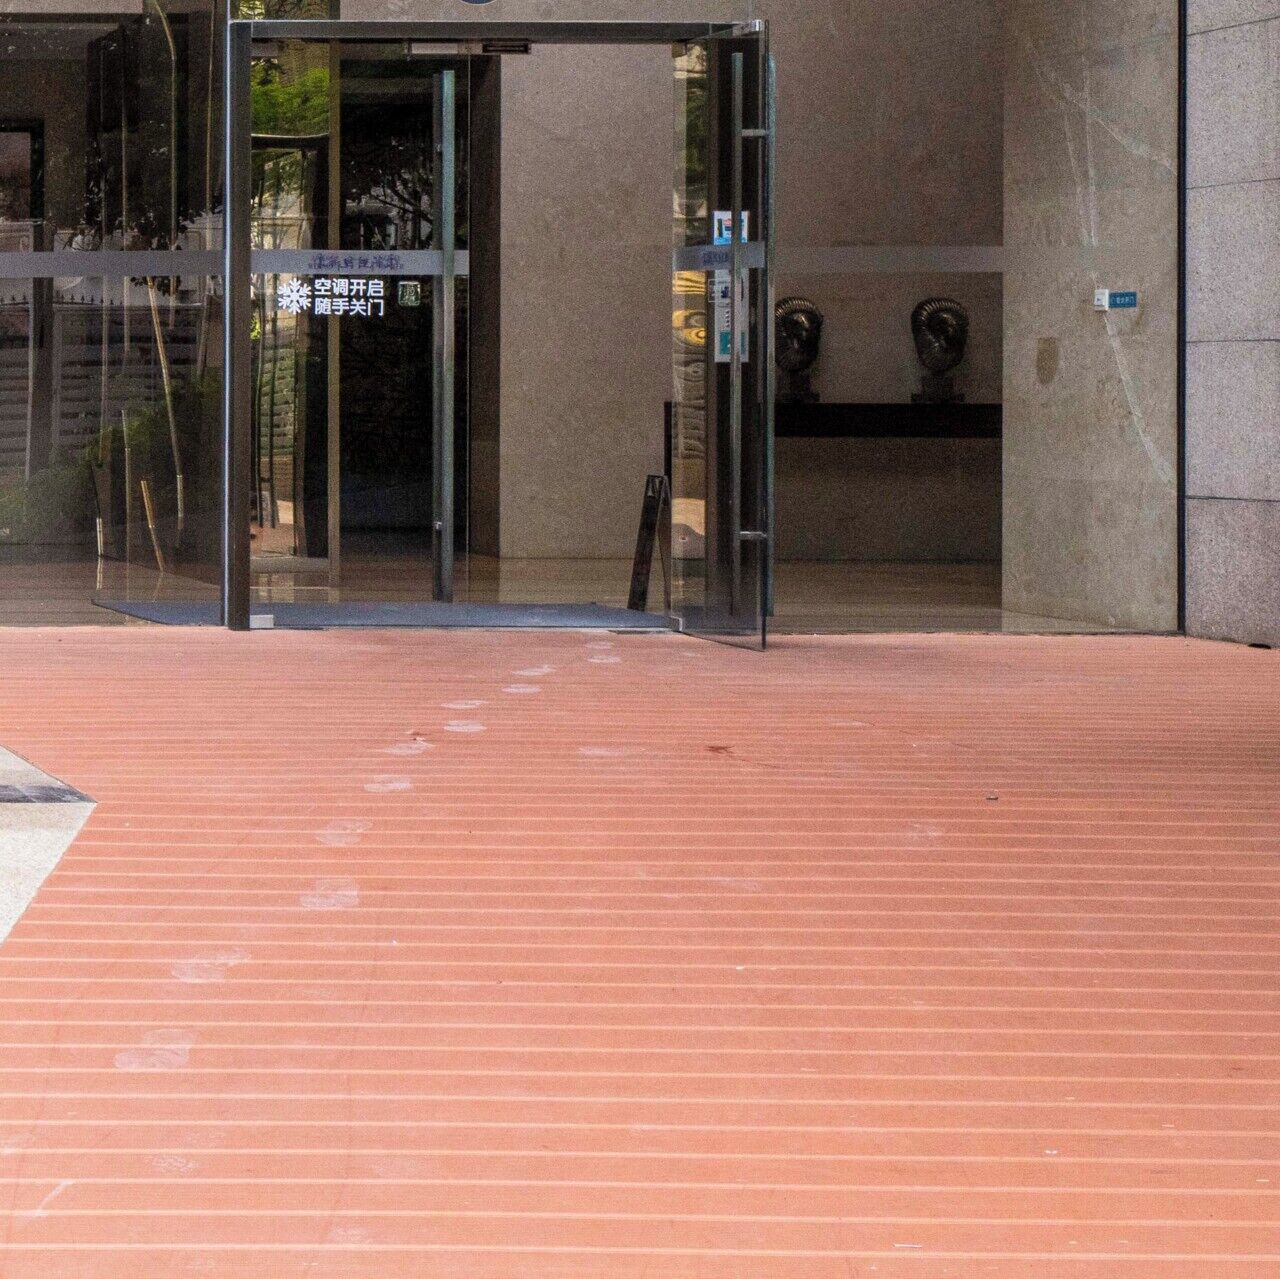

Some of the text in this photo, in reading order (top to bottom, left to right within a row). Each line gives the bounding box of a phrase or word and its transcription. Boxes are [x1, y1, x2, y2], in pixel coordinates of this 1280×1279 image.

[314, 277, 384, 297] 空调开启
[314, 297, 384, 316] 随手关门
